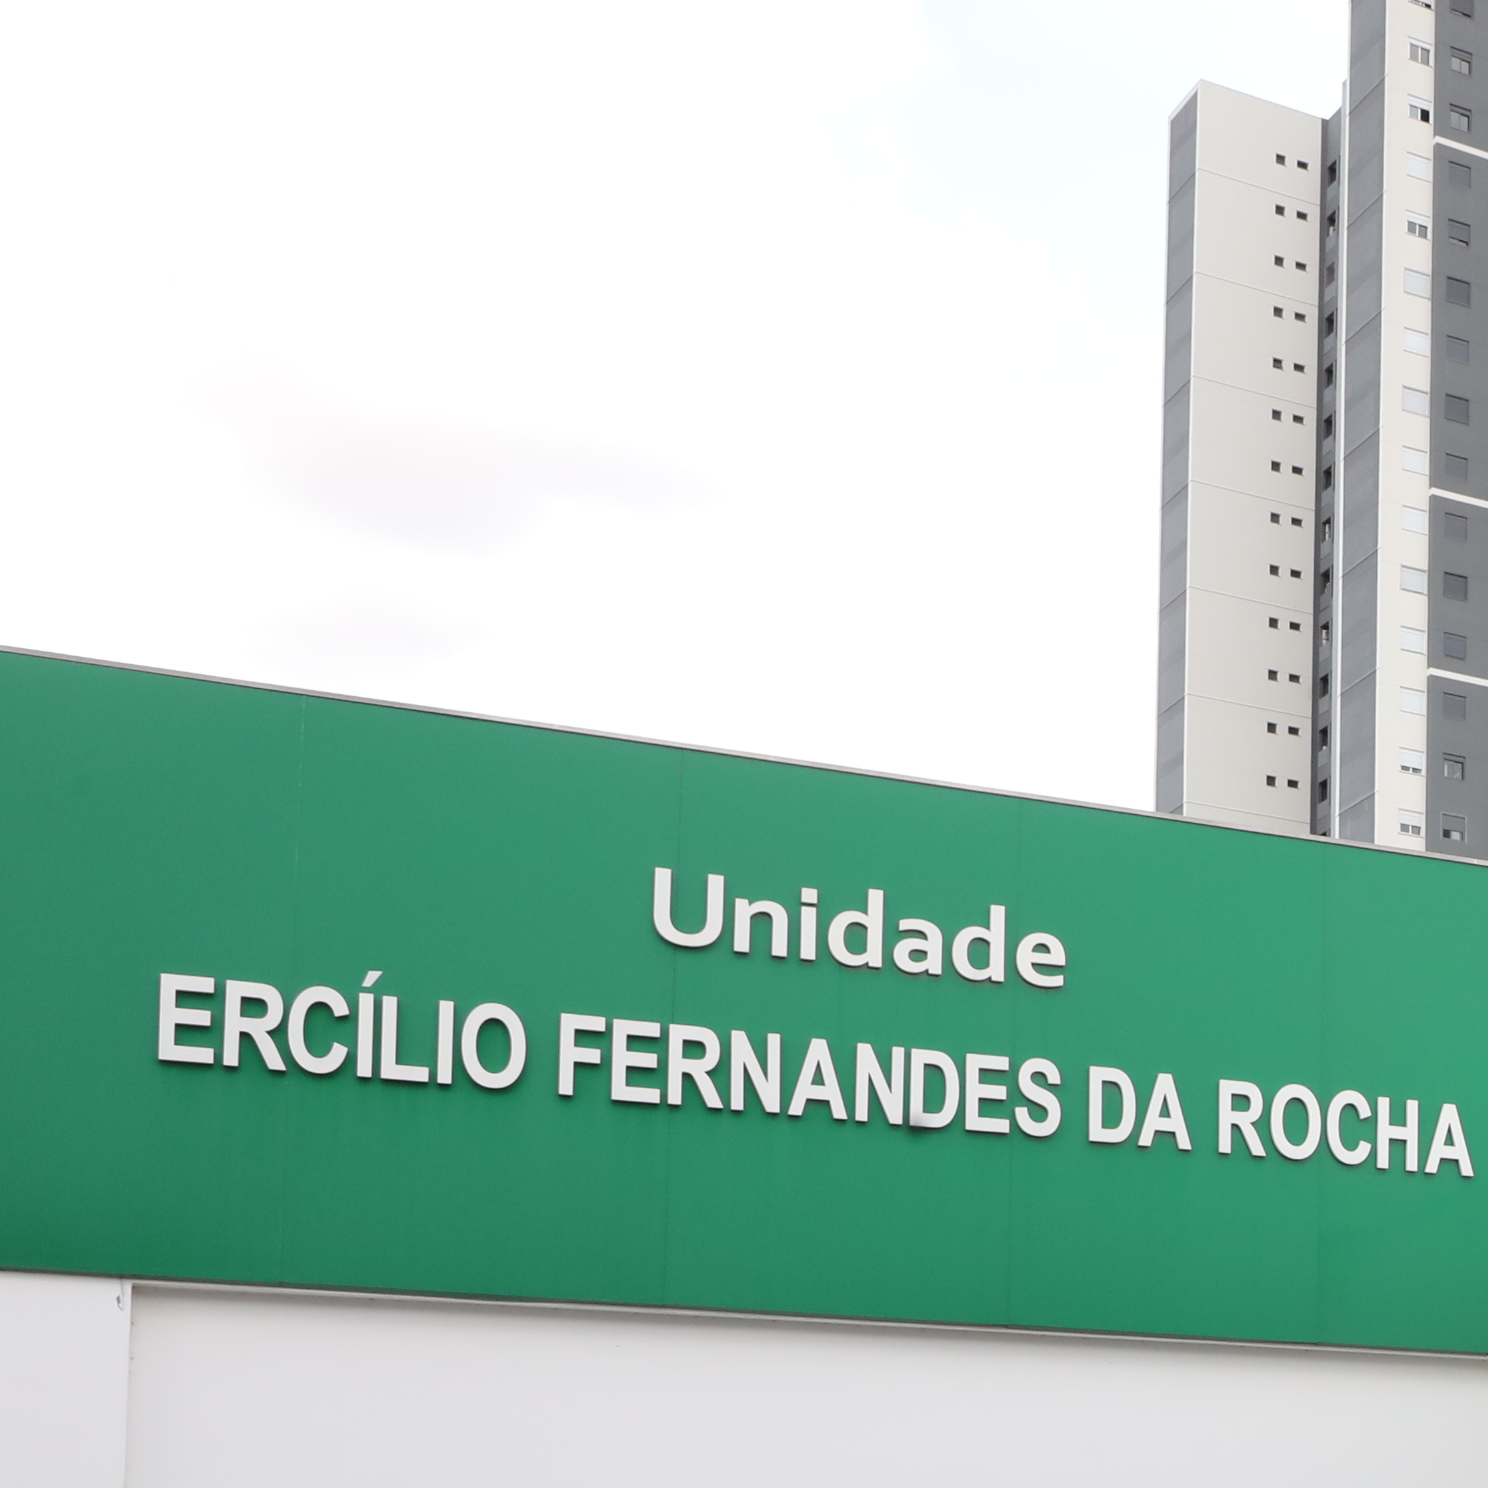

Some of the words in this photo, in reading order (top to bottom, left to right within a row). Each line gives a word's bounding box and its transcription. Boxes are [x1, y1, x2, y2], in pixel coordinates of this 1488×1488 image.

[652, 867, 1067, 988] Unidade
[158, 970, 527, 1090] ERCÍLIO
[557, 1012, 1062, 1138] FERNANDES
[1088, 1066, 1192, 1151] DA
[1218, 1078, 1475, 1178] ROCHA
